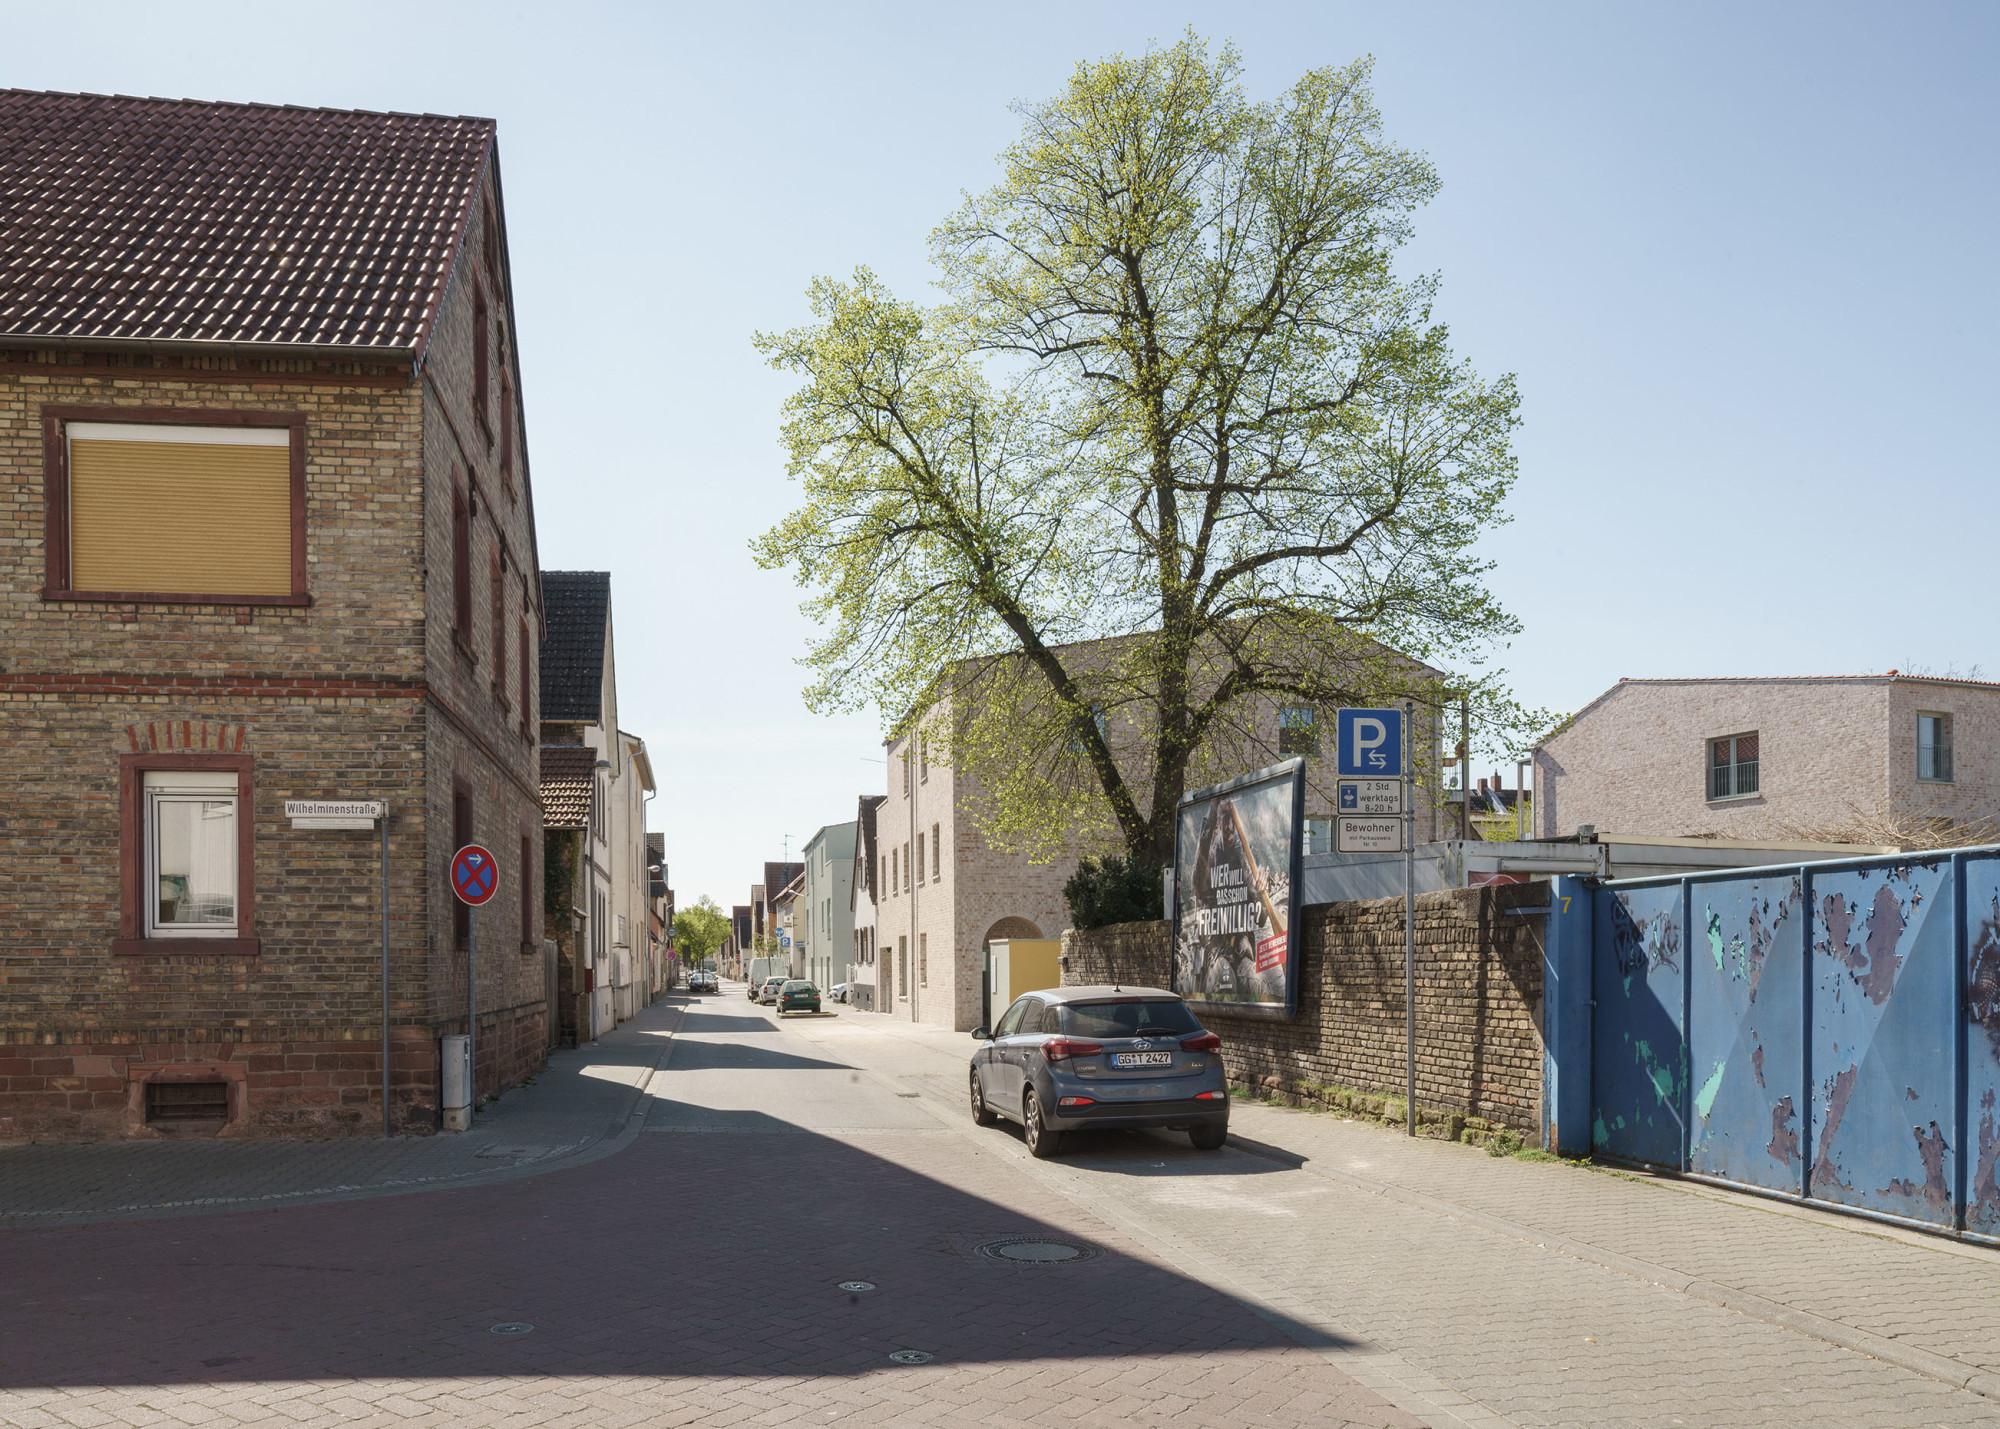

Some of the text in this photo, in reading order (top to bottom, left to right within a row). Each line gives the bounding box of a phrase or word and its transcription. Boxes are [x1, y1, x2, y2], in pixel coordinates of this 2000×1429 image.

[1353, 717, 1387, 767] P
[1366, 782, 1372, 791] 2
[1360, 794, 1399, 803] werktags
[287, 803, 376, 814] Wilhelminenstraße
[1365, 804, 1393, 812] 8-20 h
[1345, 822, 1395, 832] Bewohner
[1210, 863, 1244, 889] WER WILL
[1228, 886, 1248, 903] SCHON
[1560, 896, 1571, 914] 7
[1199, 901, 1262, 936] FREIWILLIG?
[1118, 1053, 1169, 1064] GG T 2427
